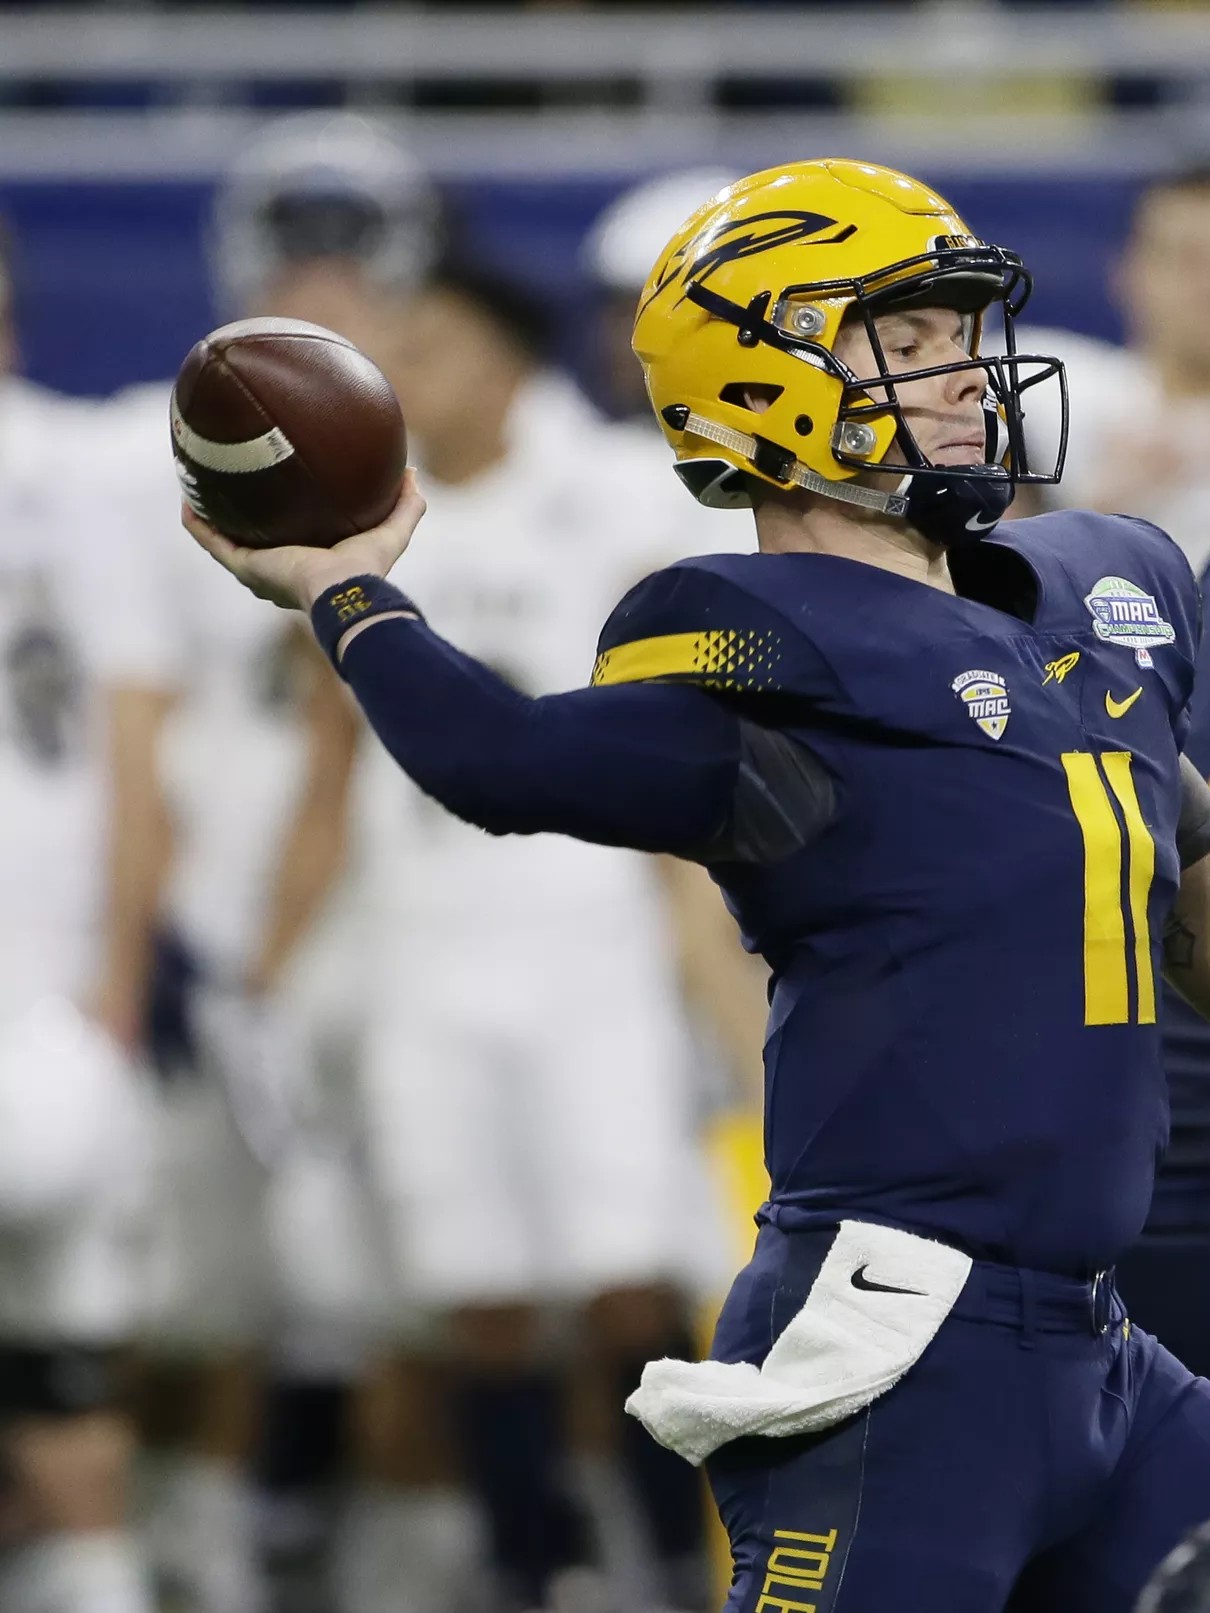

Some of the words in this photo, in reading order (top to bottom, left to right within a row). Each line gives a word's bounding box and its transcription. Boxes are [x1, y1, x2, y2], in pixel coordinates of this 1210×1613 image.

[1109, 600, 1157, 623] MAC
[967, 698, 1011, 718] MAC
[1060, 751, 1156, 1026] 11
